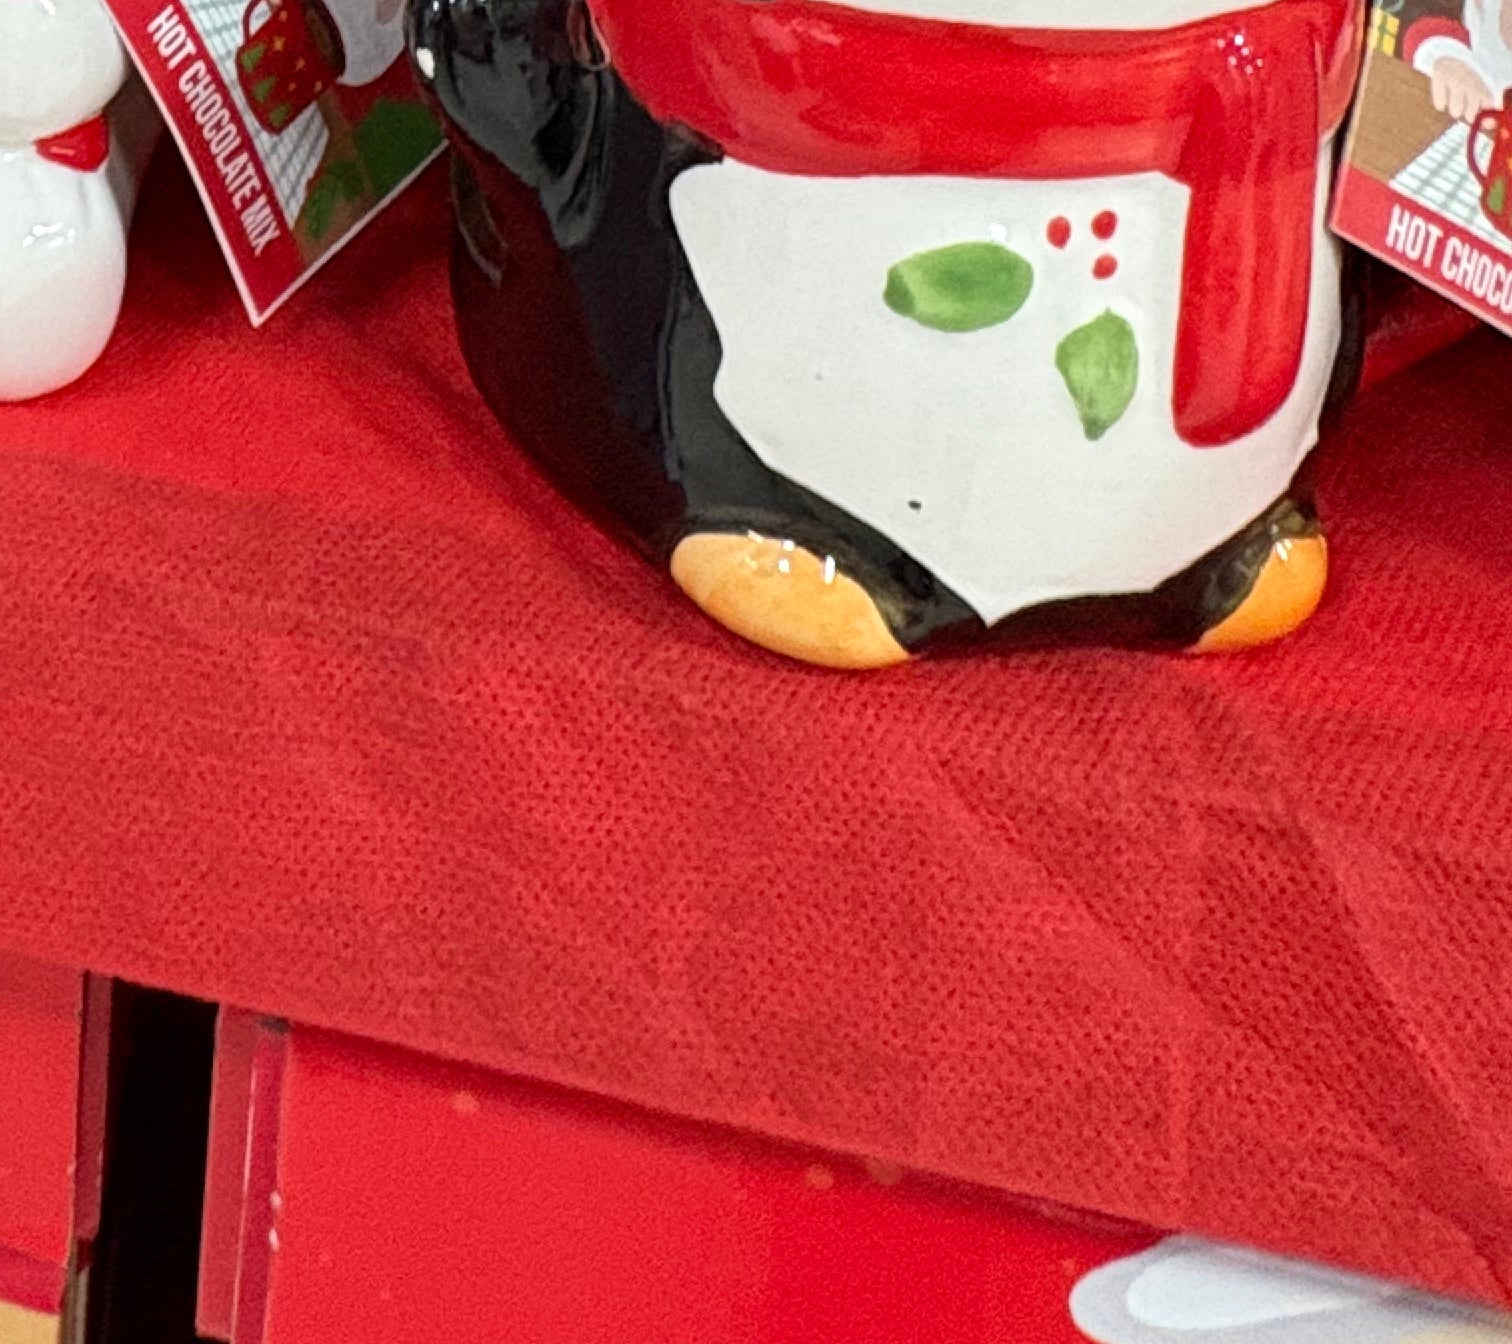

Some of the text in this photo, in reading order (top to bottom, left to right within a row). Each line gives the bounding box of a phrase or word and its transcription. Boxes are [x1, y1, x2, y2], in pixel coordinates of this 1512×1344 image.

[146, 4, 280, 257] HOT CHOCOLATE MIX
[1385, 203, 1444, 268] HOT
